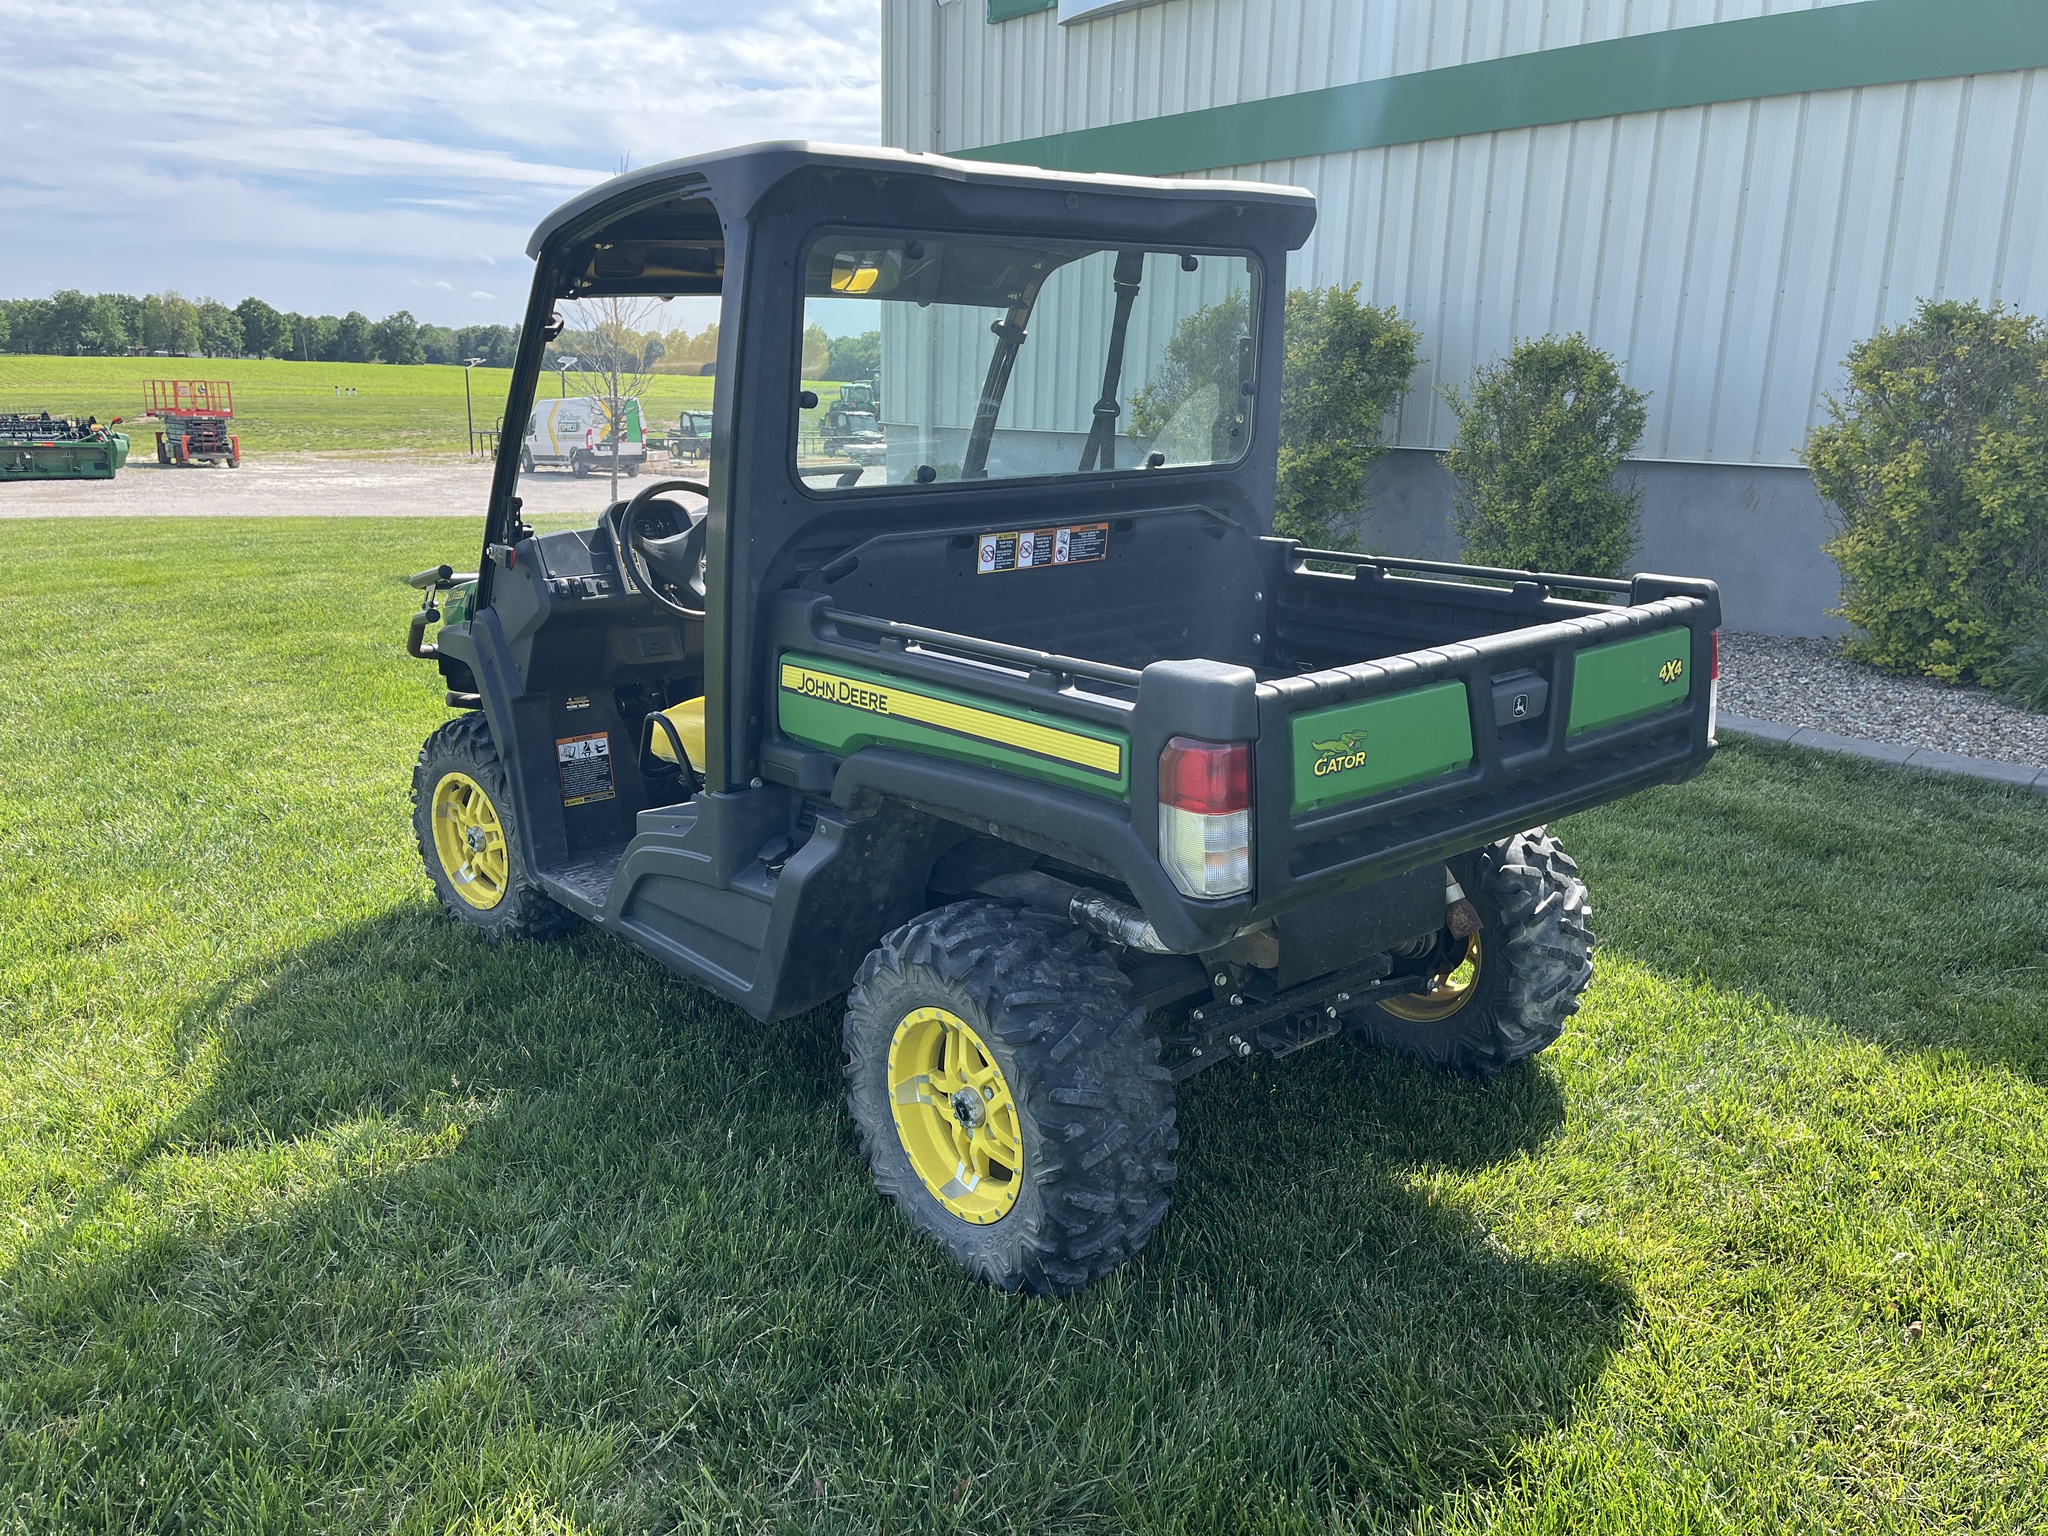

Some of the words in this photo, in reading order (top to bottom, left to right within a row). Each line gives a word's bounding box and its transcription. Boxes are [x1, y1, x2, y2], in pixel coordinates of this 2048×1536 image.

[1658, 659, 1682, 682] 4X4
[797, 673, 835, 699] JOHN
[839, 681, 888, 712] DEERE
[1314, 751, 1367, 777] GATOR
